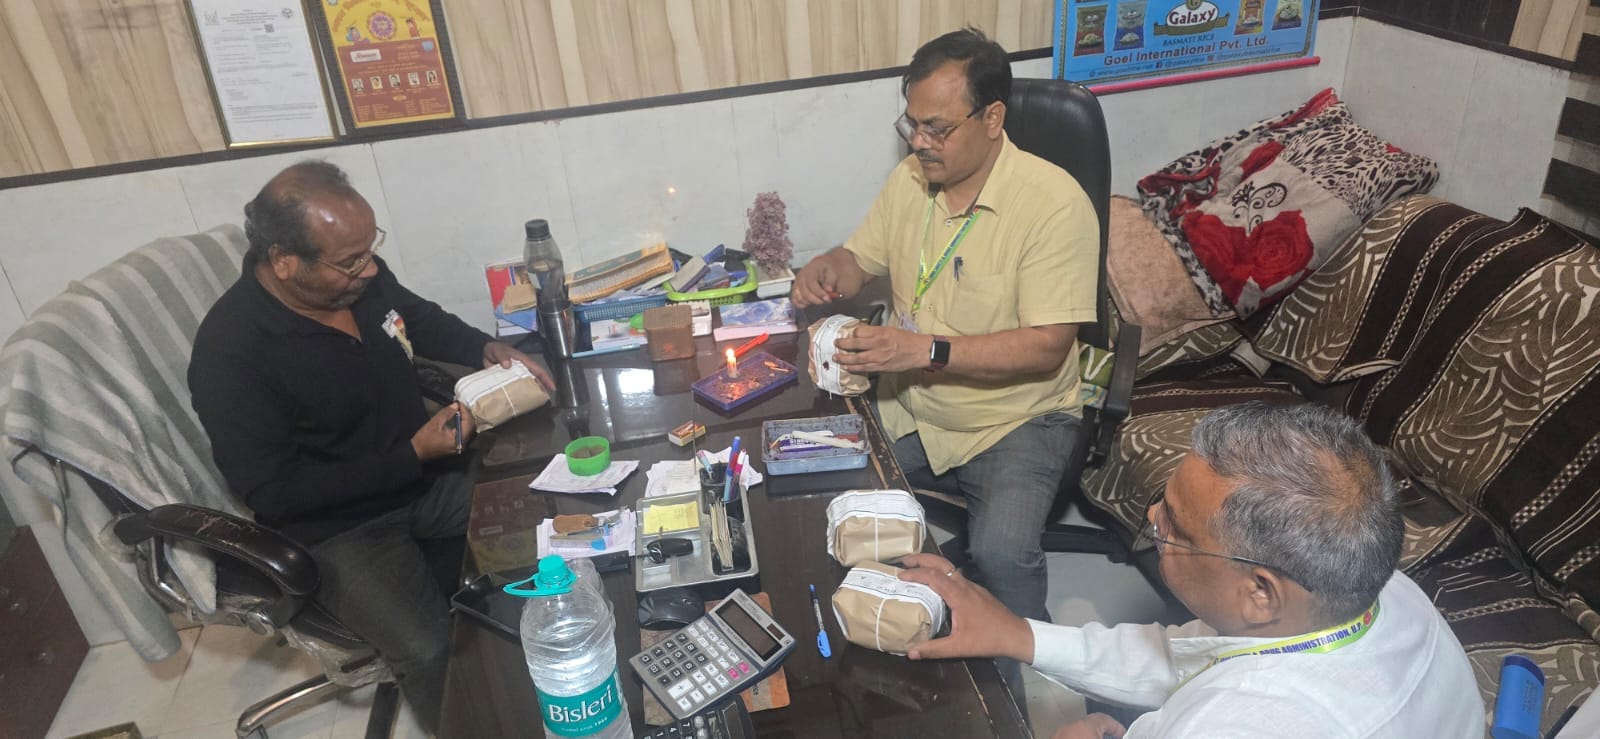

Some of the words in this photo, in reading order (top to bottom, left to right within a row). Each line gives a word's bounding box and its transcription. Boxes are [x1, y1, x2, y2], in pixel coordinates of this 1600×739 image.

[1168, 8, 1216, 25] Galaxy
[1104, 52, 1132, 66] Goel
[1136, 42, 1216, 61] International
[1219, 39, 1242, 50] Pvt.
[548, 684, 613, 723] Bisleri
